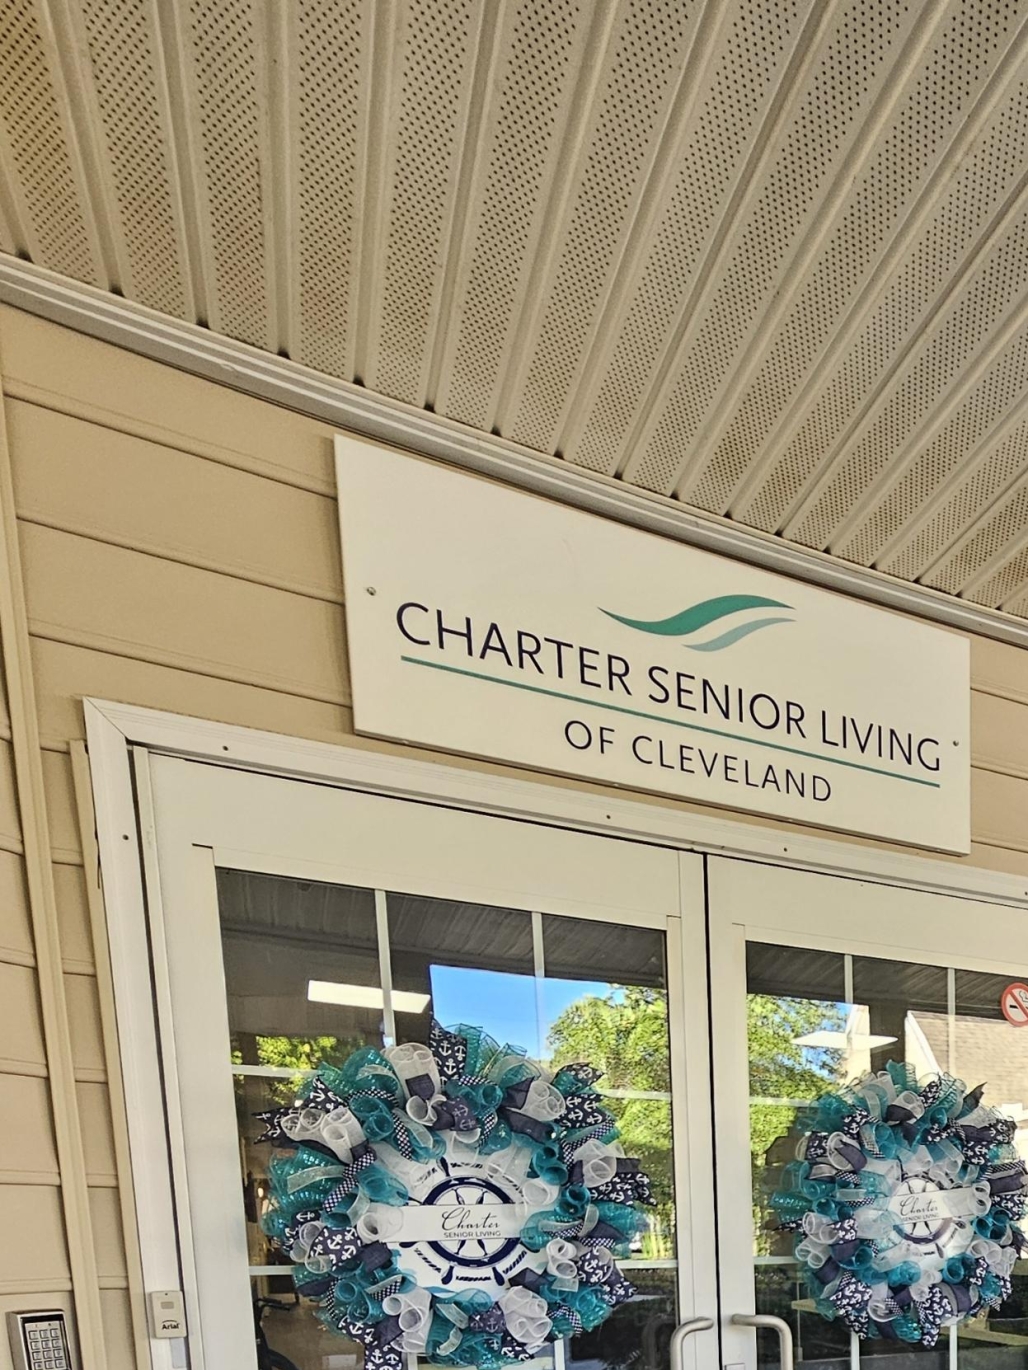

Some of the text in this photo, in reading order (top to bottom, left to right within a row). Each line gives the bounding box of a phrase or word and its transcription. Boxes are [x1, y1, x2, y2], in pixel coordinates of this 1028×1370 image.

[396, 602, 940, 772] CHARTER SENIOR LIVING
[564, 720, 831, 802] OF CLEVELAND
[900, 1195, 939, 1216] Charter
[441, 1207, 500, 1230] Charter
[443, 1230, 502, 1239] SENIOR LIVING
